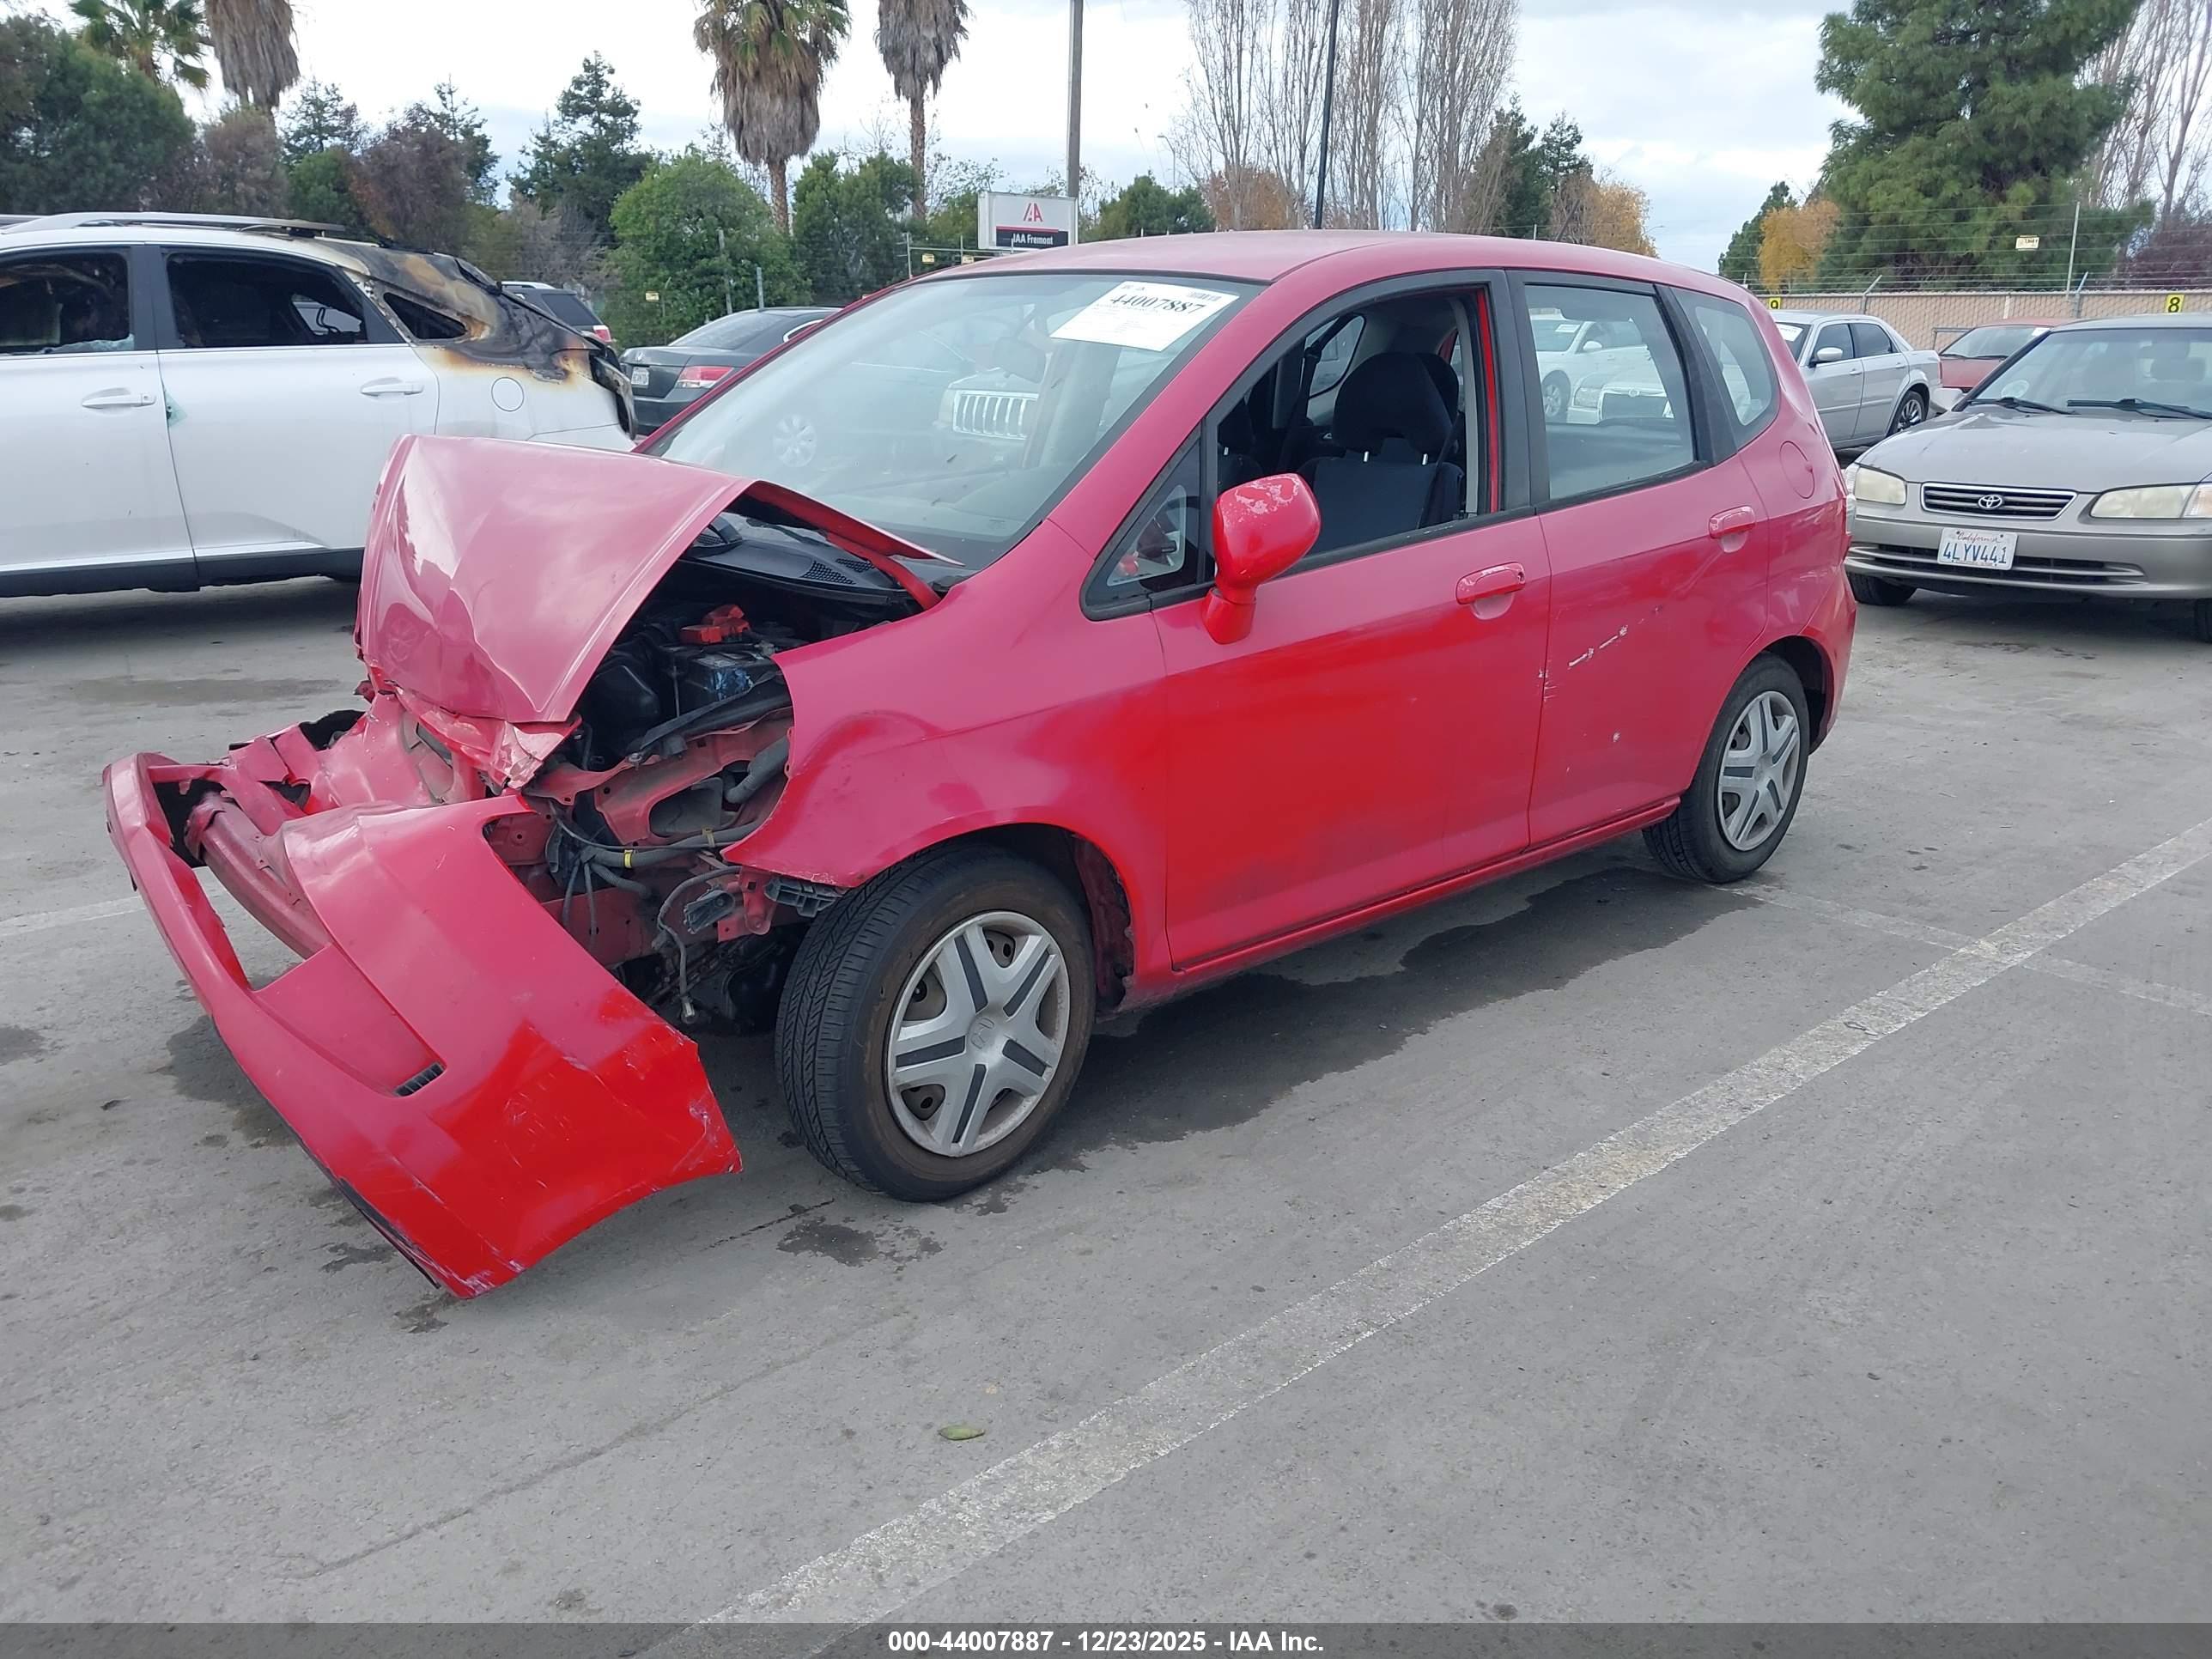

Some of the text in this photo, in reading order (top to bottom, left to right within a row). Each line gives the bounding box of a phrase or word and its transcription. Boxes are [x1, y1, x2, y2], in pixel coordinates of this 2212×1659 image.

[1026, 234, 1054, 246] Fremont
[1110, 294, 1207, 314] 44007887
[2168, 296, 2180, 313] 8
[1957, 532, 2002, 544] California
[1942, 542, 2007, 564] 4LYV441
